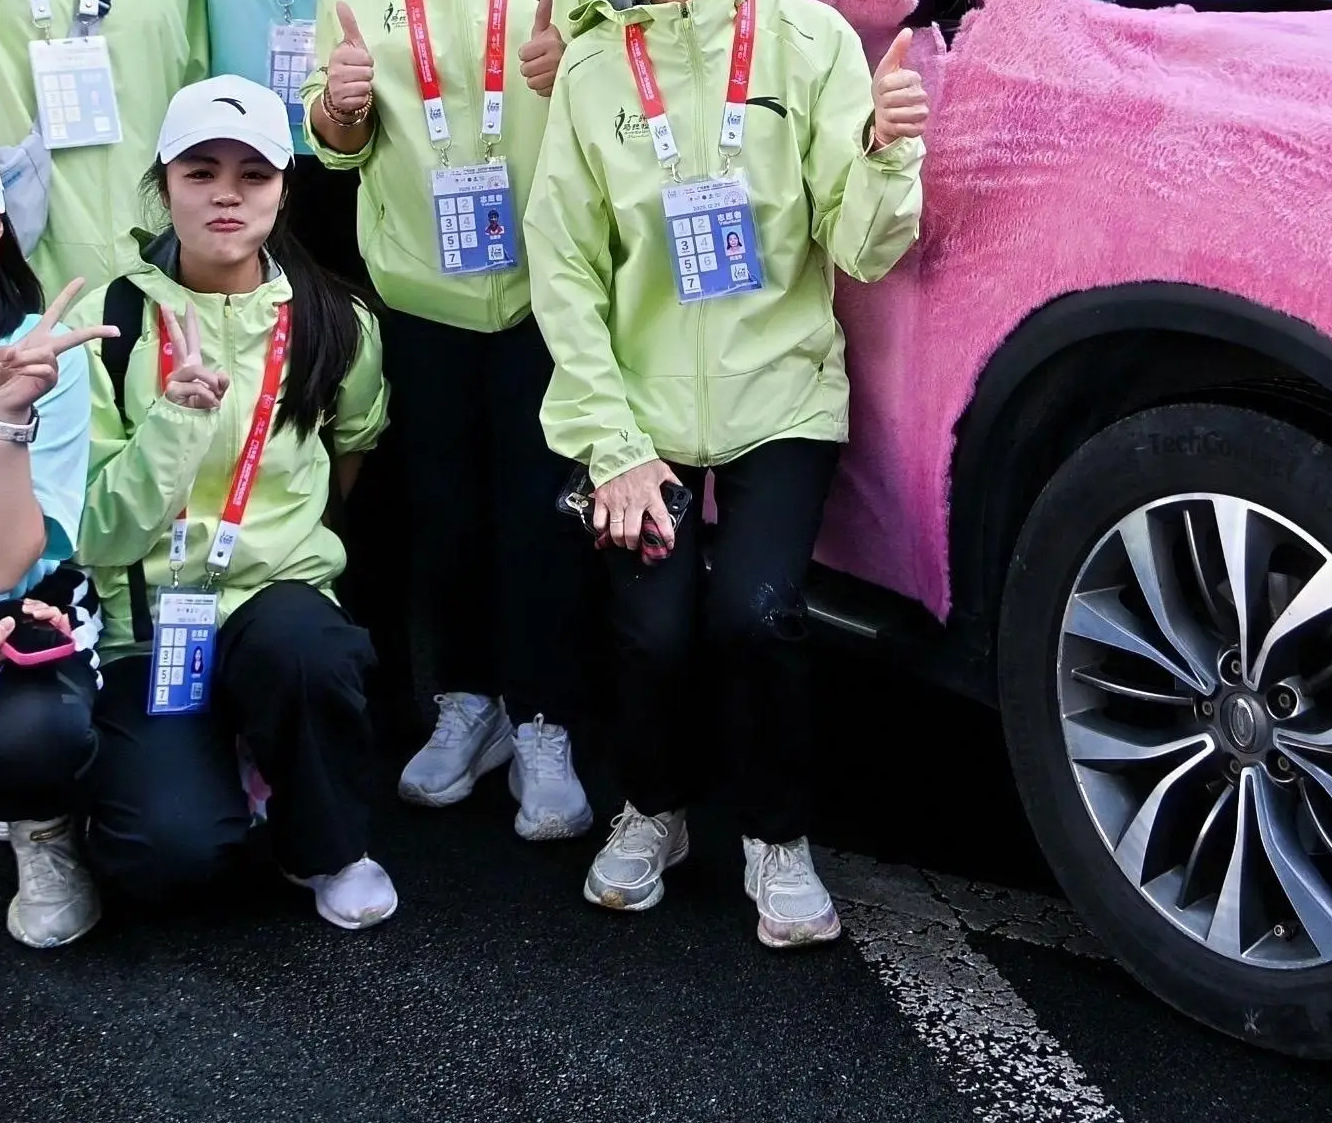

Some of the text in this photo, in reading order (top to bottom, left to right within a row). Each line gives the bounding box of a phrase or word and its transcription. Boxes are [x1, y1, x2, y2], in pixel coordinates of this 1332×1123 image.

[461, 198, 470, 209] 2
[445, 218, 454, 229] 3
[697, 218, 706, 229] 2
[447, 235, 455, 246] 5
[680, 240, 690, 251] 3
[449, 253, 457, 263] 7
[703, 255, 712, 266] 6
[684, 259, 693, 270] 5
[687, 277, 695, 289] 7
